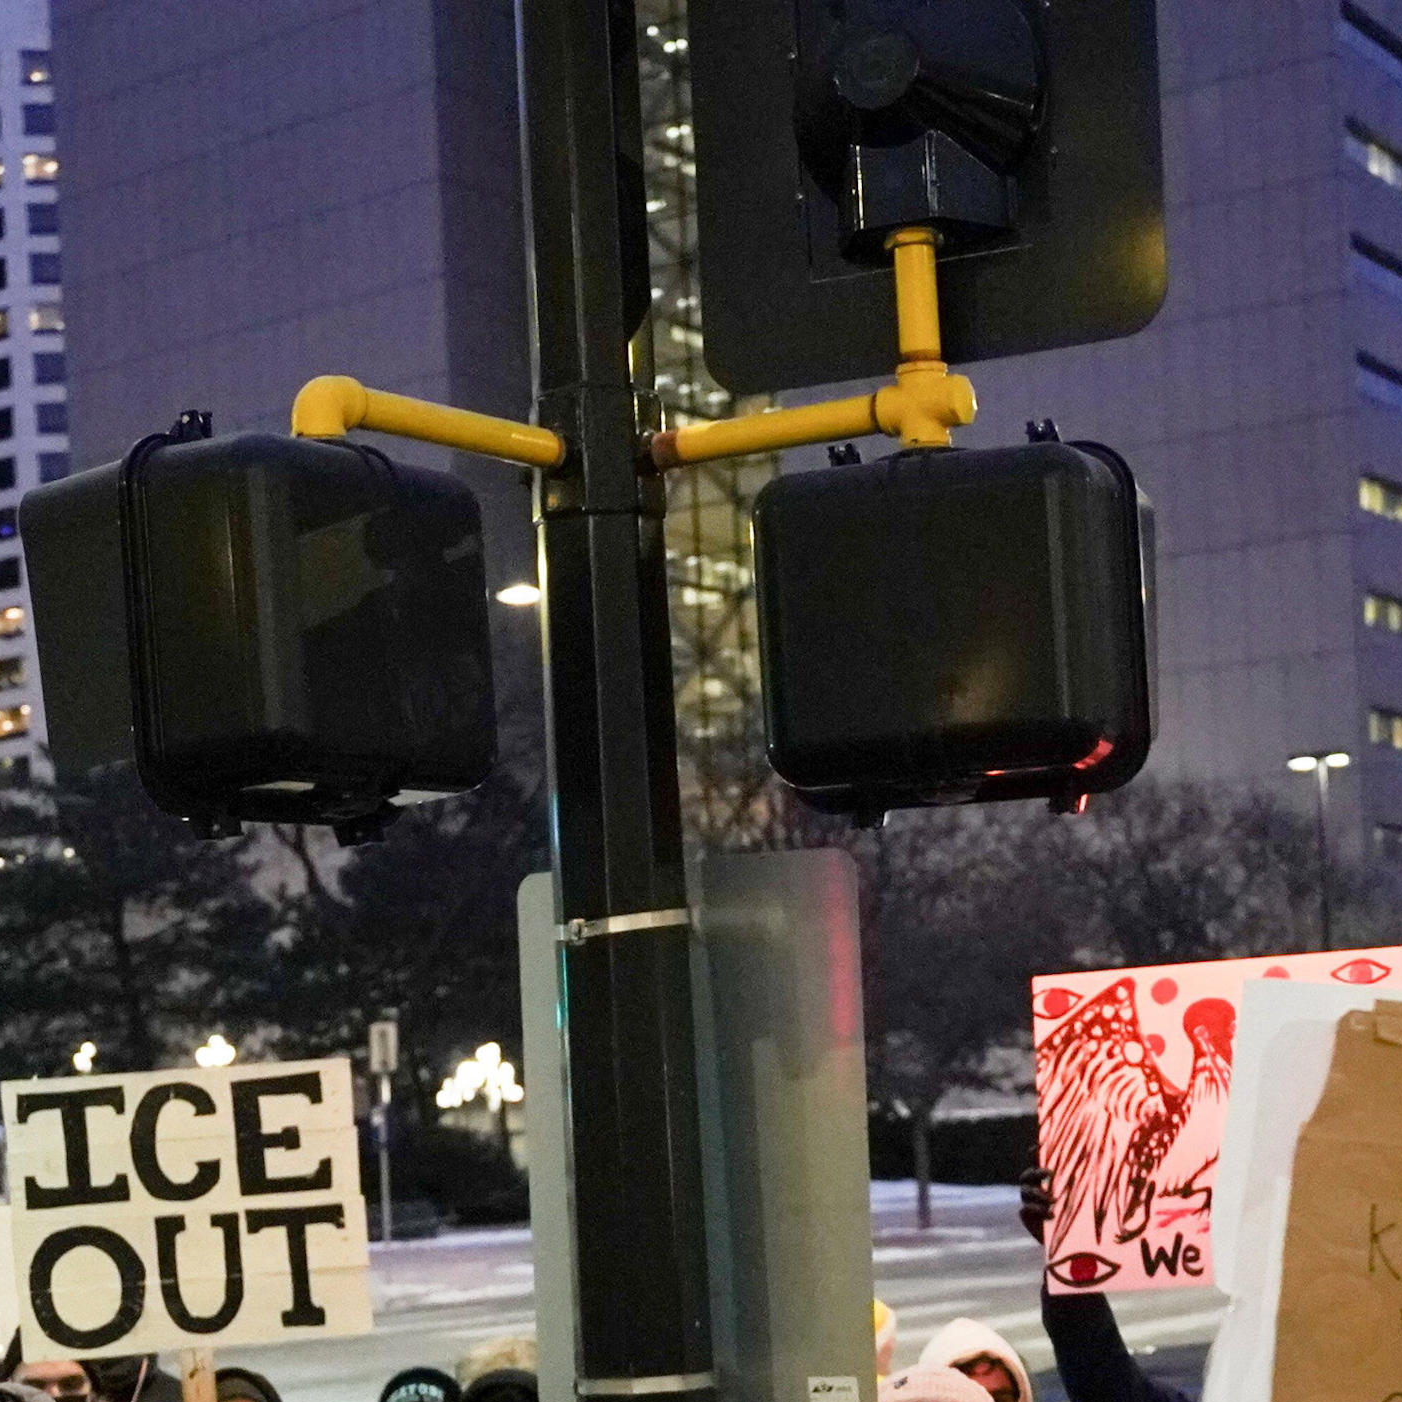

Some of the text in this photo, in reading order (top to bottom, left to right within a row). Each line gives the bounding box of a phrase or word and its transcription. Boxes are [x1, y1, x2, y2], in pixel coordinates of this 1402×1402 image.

[17, 1071, 333, 1210] ICE
[29, 1203, 346, 1349] OUT
[1139, 1233, 1204, 1278] We
